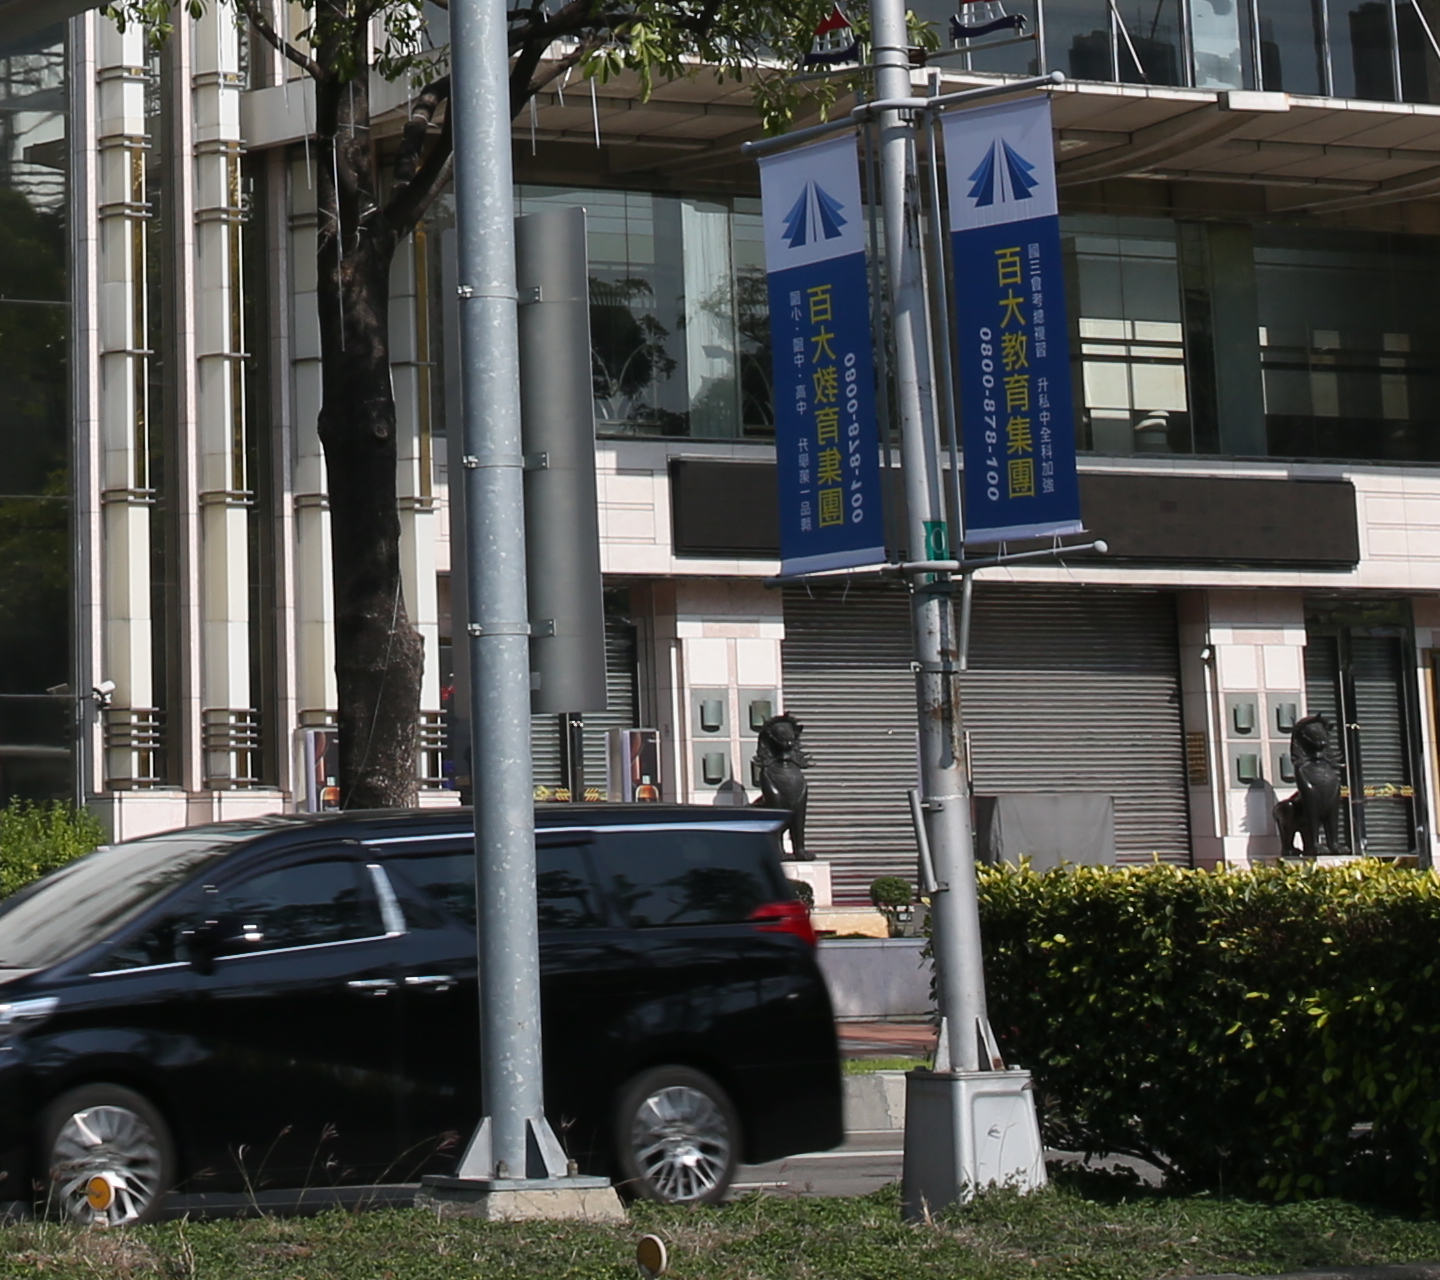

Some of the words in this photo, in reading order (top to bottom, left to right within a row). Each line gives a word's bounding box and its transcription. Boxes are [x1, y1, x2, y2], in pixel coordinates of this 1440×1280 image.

[980, 326, 1000, 501] 0800-878-100
[995, 246, 1035, 499] 百大教育集團
